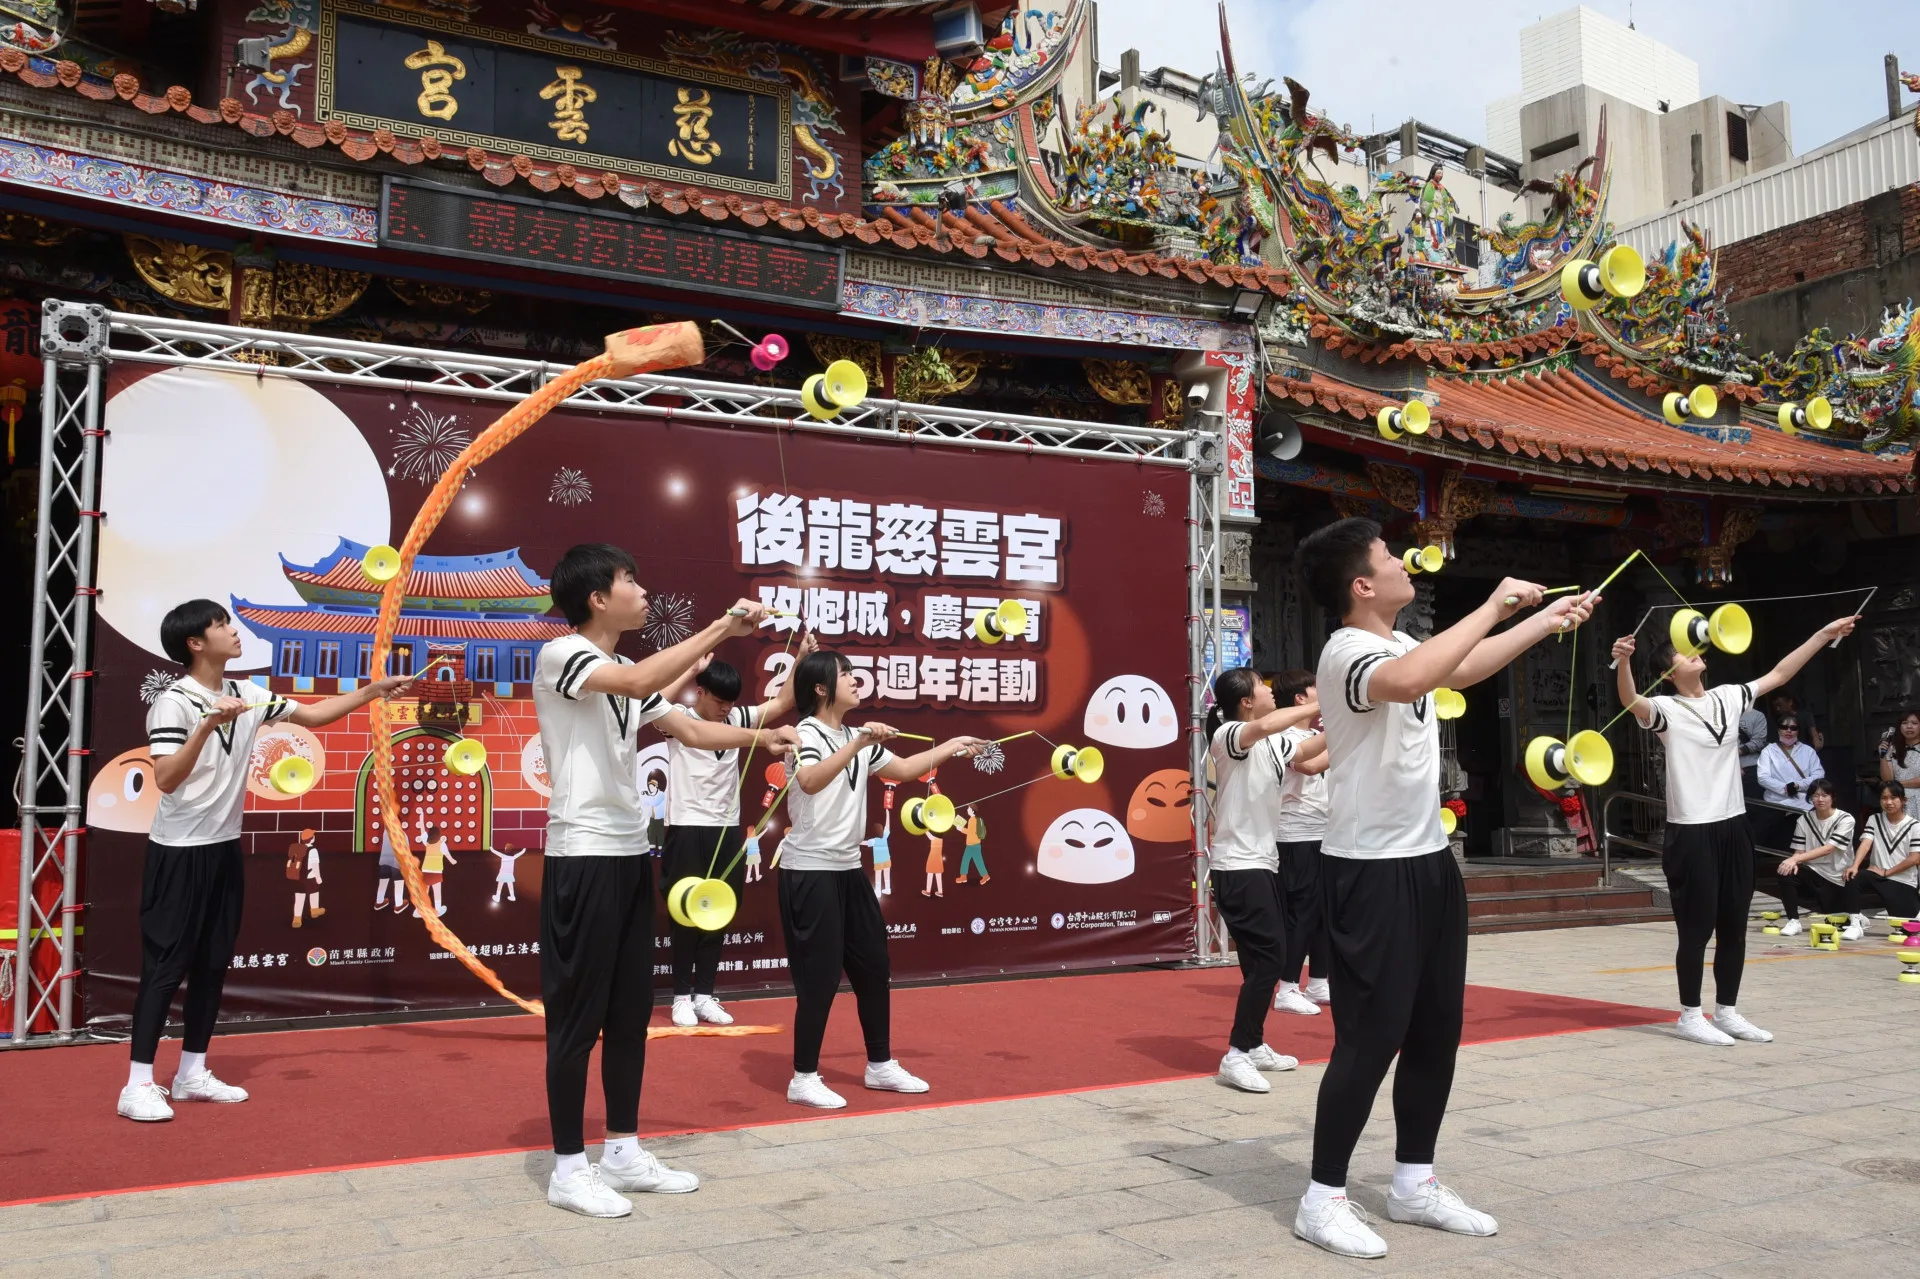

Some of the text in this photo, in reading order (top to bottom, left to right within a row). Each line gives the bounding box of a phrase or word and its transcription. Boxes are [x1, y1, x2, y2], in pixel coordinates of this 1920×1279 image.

[736, 492, 1061, 583] 後龍慈雲宮
[763, 652, 1037, 702] 25週年活動
[1081, 921, 1116, 929] Corporation,
[228, 953, 289, 969] 龍慈雲宮
[329, 947, 395, 959] 苗栗縣政府
